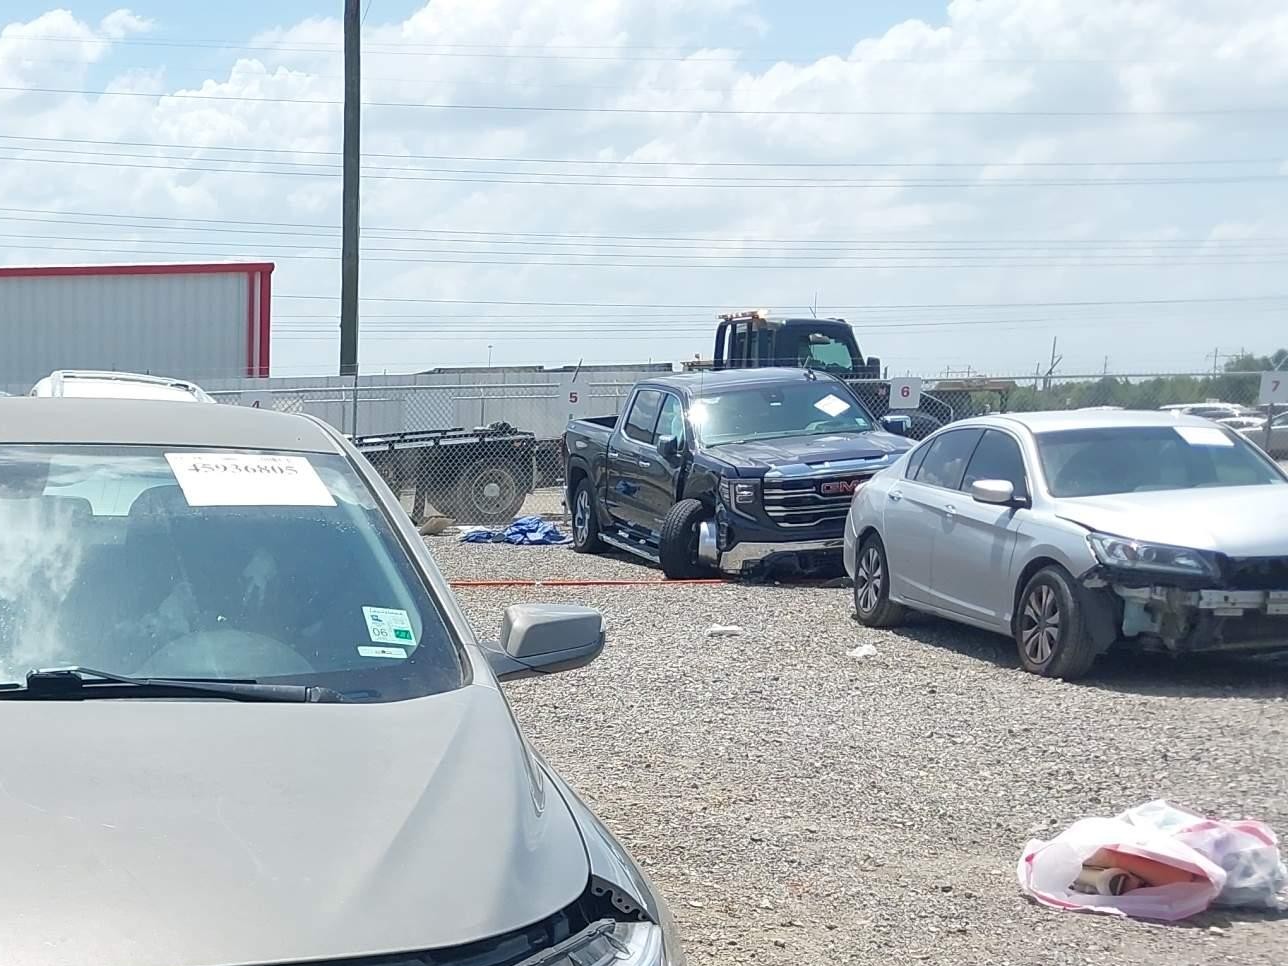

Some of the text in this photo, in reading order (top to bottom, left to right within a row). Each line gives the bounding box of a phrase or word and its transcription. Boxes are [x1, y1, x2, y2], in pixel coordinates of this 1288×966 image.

[901, 386, 910, 398] 6
[1272, 380, 1280, 392] 7
[569, 392, 578, 404] 5
[188, 463, 299, 476] 45936805
[821, 479, 870, 494] GM
[372, 627, 389, 637] 06
